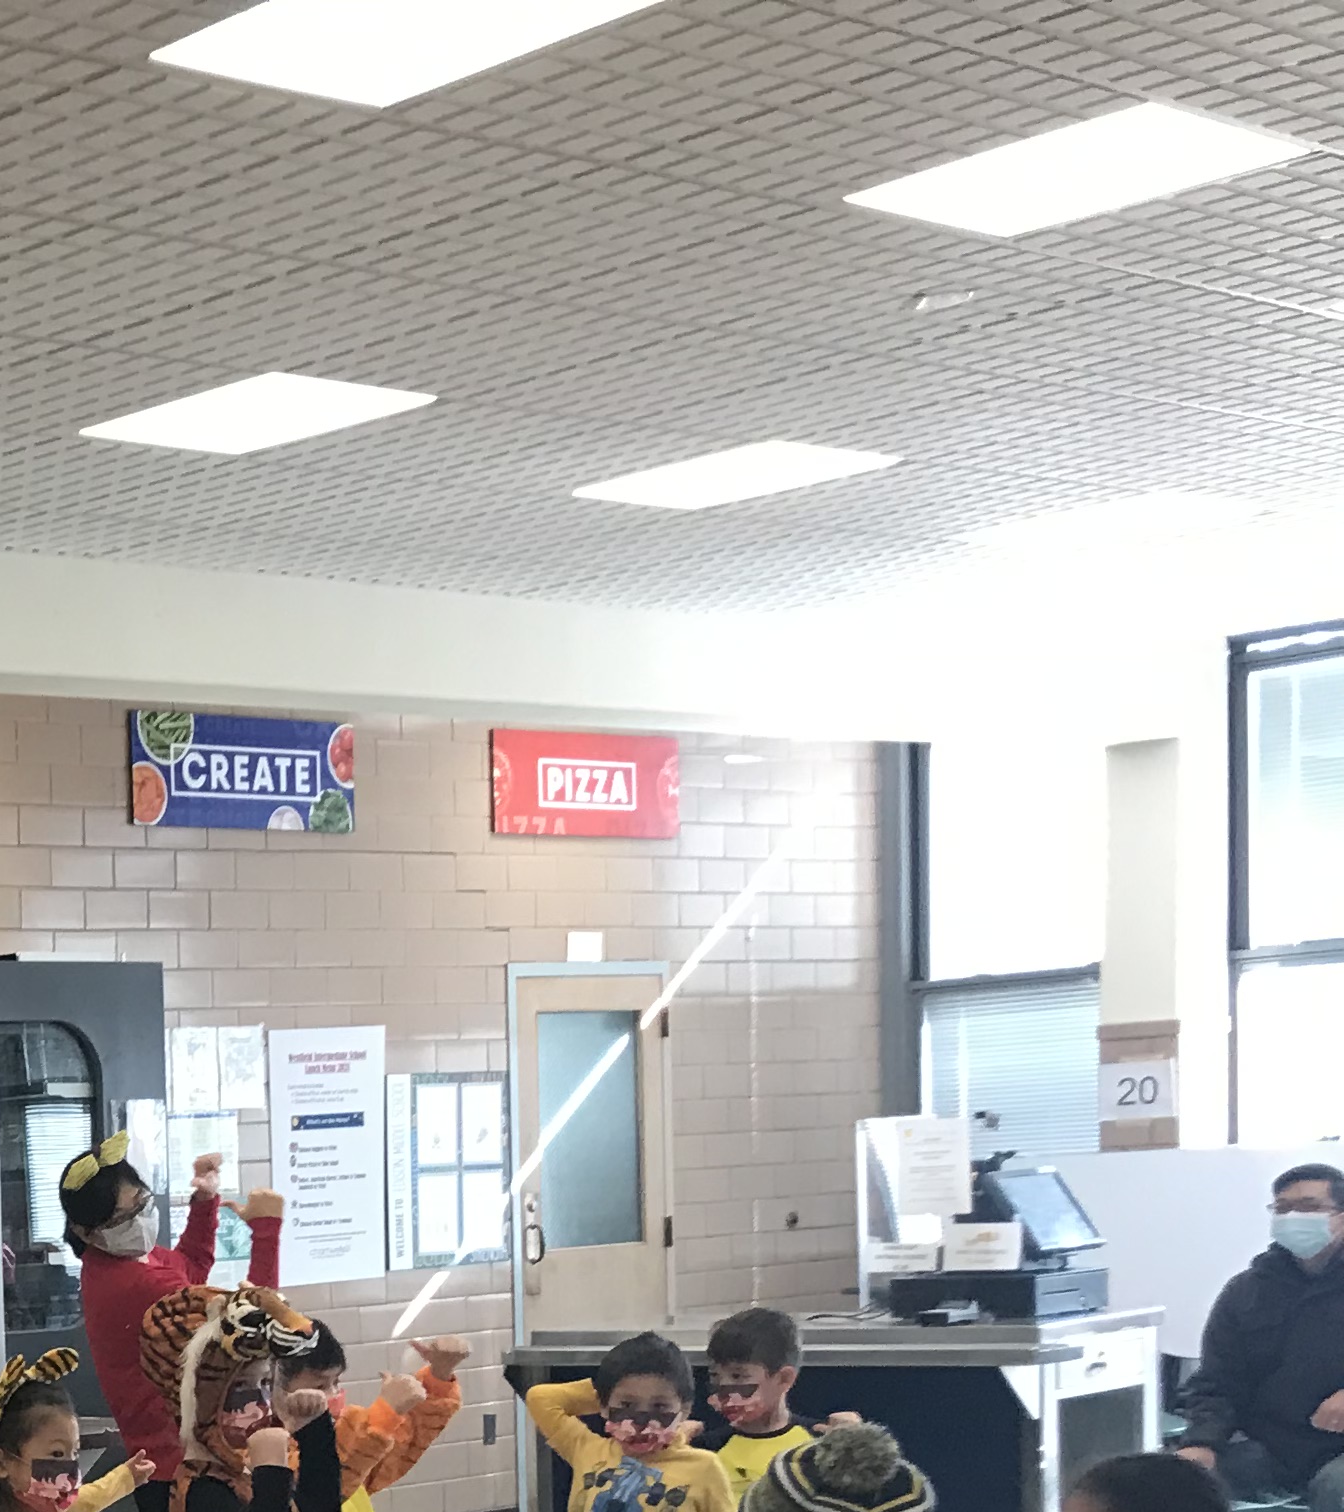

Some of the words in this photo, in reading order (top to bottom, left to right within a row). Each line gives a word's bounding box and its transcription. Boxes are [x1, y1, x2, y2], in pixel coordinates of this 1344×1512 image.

[181, 752, 311, 794] CREATE
[546, 766, 629, 804] PIZZA
[1116, 1075, 1160, 1106] 20
